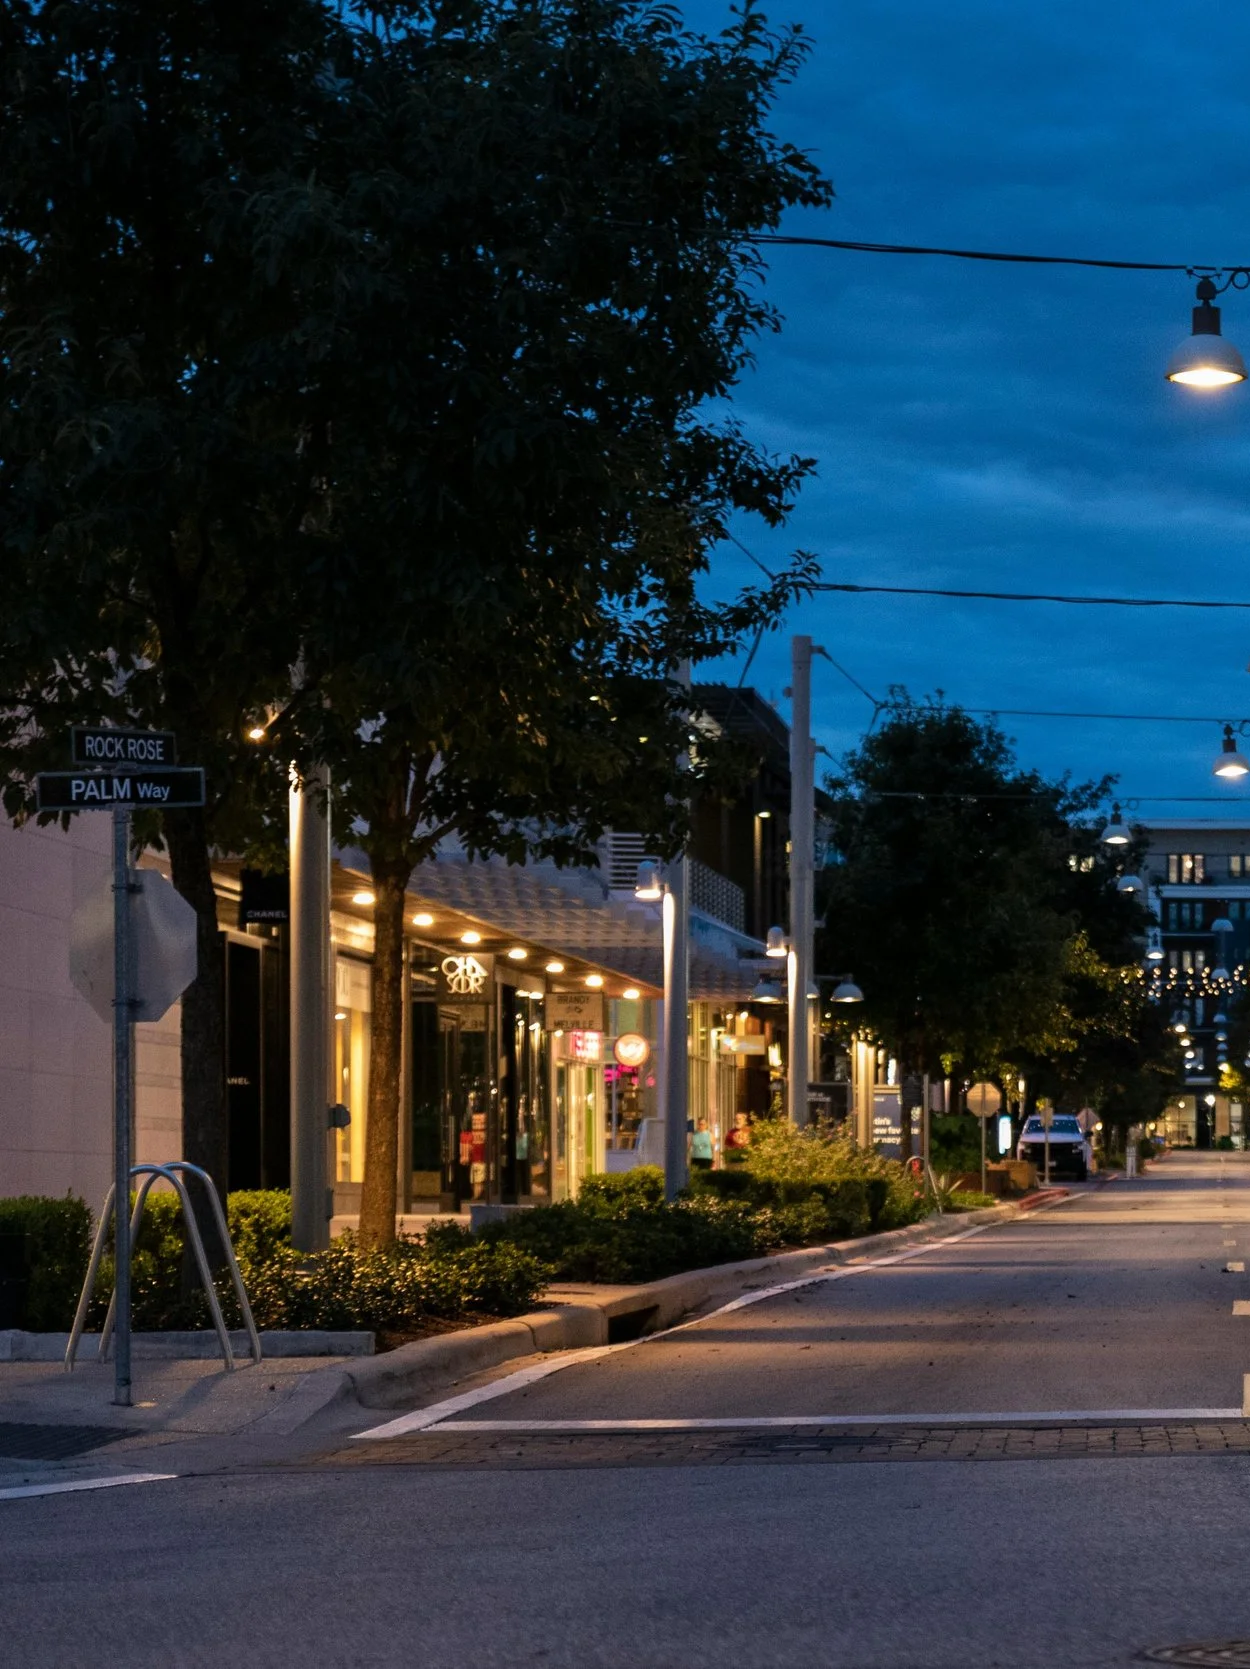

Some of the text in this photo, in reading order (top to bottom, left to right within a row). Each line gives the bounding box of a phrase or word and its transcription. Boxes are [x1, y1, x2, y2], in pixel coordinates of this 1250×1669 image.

[85, 736, 164, 760] ROCK ROSE
[71, 778, 170, 801] PALM Way
[247, 910, 288, 919] CHANEL
[557, 995, 591, 1005] BRANDY
[553, 1019, 595, 1029] MELVILLE
[873, 1117, 891, 1125] tin's
